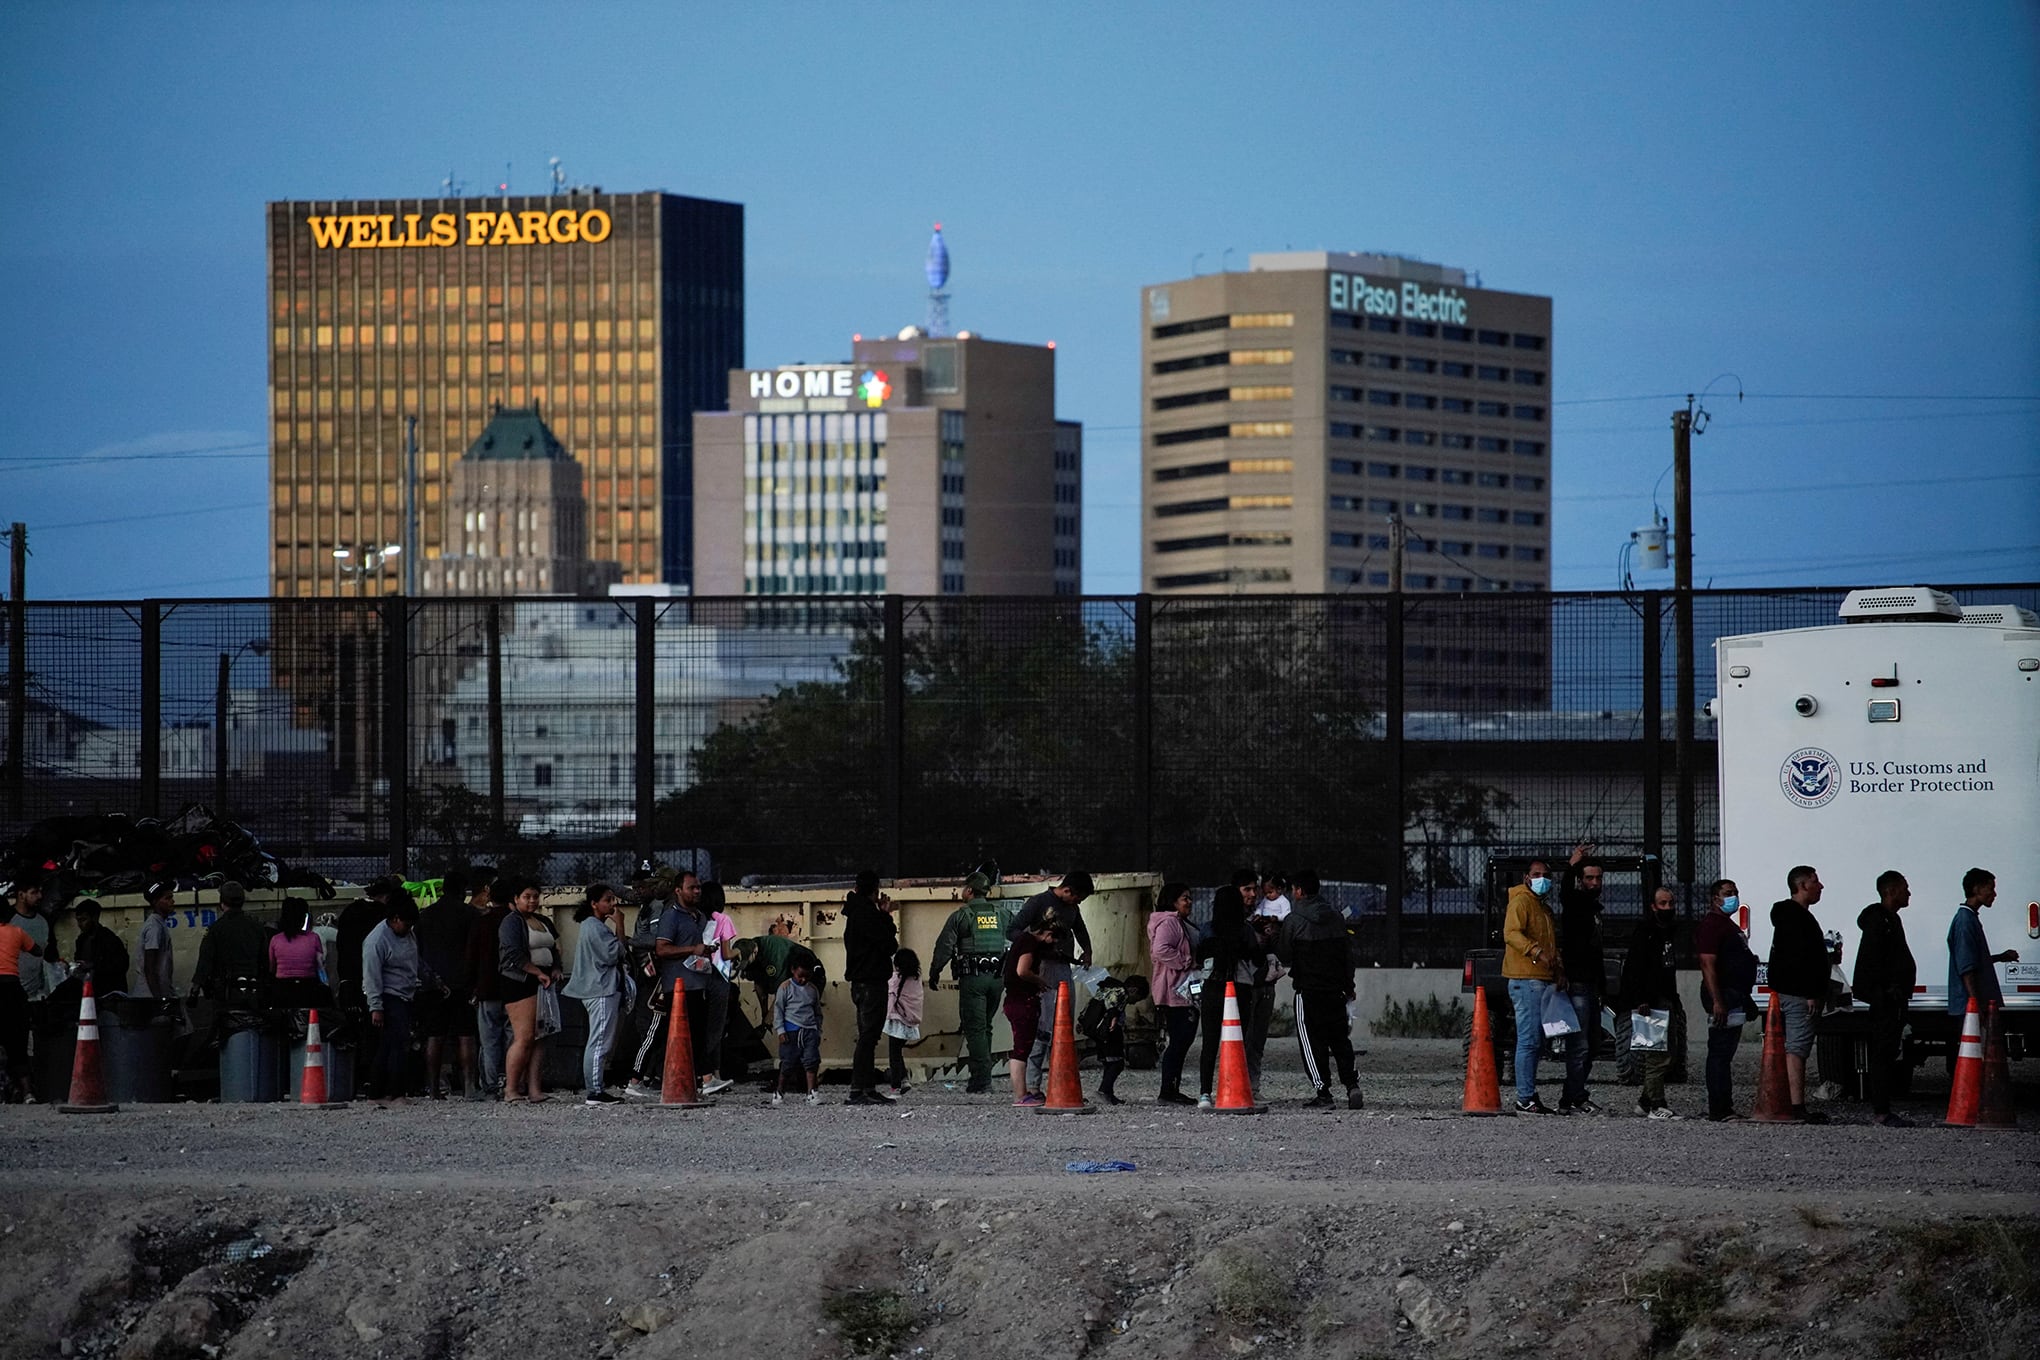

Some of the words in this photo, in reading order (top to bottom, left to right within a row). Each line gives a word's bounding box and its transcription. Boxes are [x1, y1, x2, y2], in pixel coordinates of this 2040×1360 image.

[307, 213, 457, 248] WELLS
[465, 209, 612, 246] FARGO
[1330, 273, 1348, 311] El
[1352, 275, 1398, 317] Paso
[1401, 281, 1467, 325] Electric
[750, 370, 853, 398] HOME
[1849, 761, 1879, 776] U.S.
[1883, 761, 1953, 775] Customs
[1957, 759, 1987, 774] and
[1850, 778, 1905, 793] Border
[1910, 777, 1994, 792] Protection
[977, 916, 998, 925] POLICE
